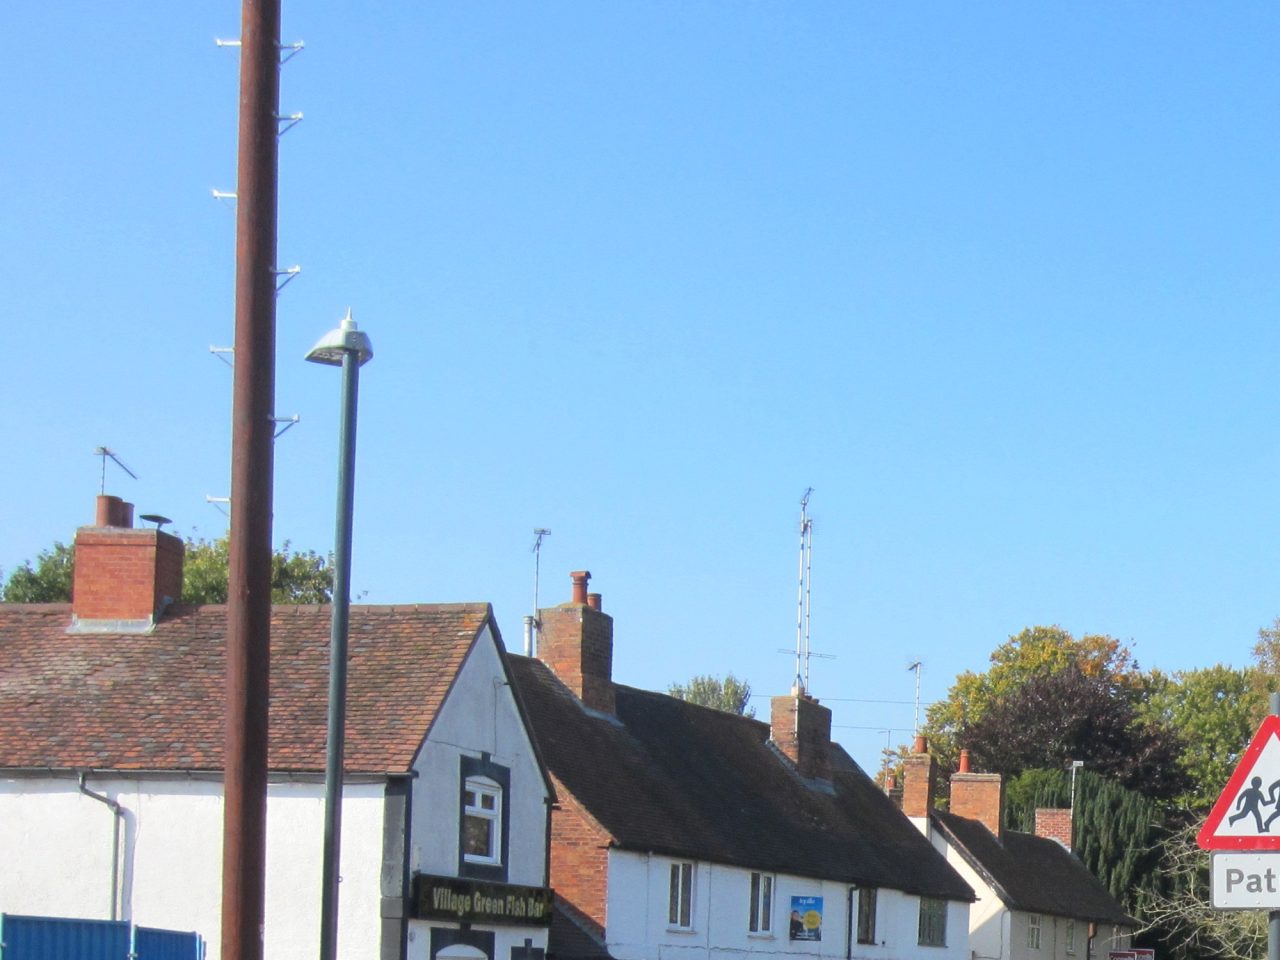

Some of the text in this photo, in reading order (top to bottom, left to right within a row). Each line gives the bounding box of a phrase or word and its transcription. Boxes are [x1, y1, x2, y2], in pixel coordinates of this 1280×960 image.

[432, 887, 545, 918] Village Green Fish Bar
